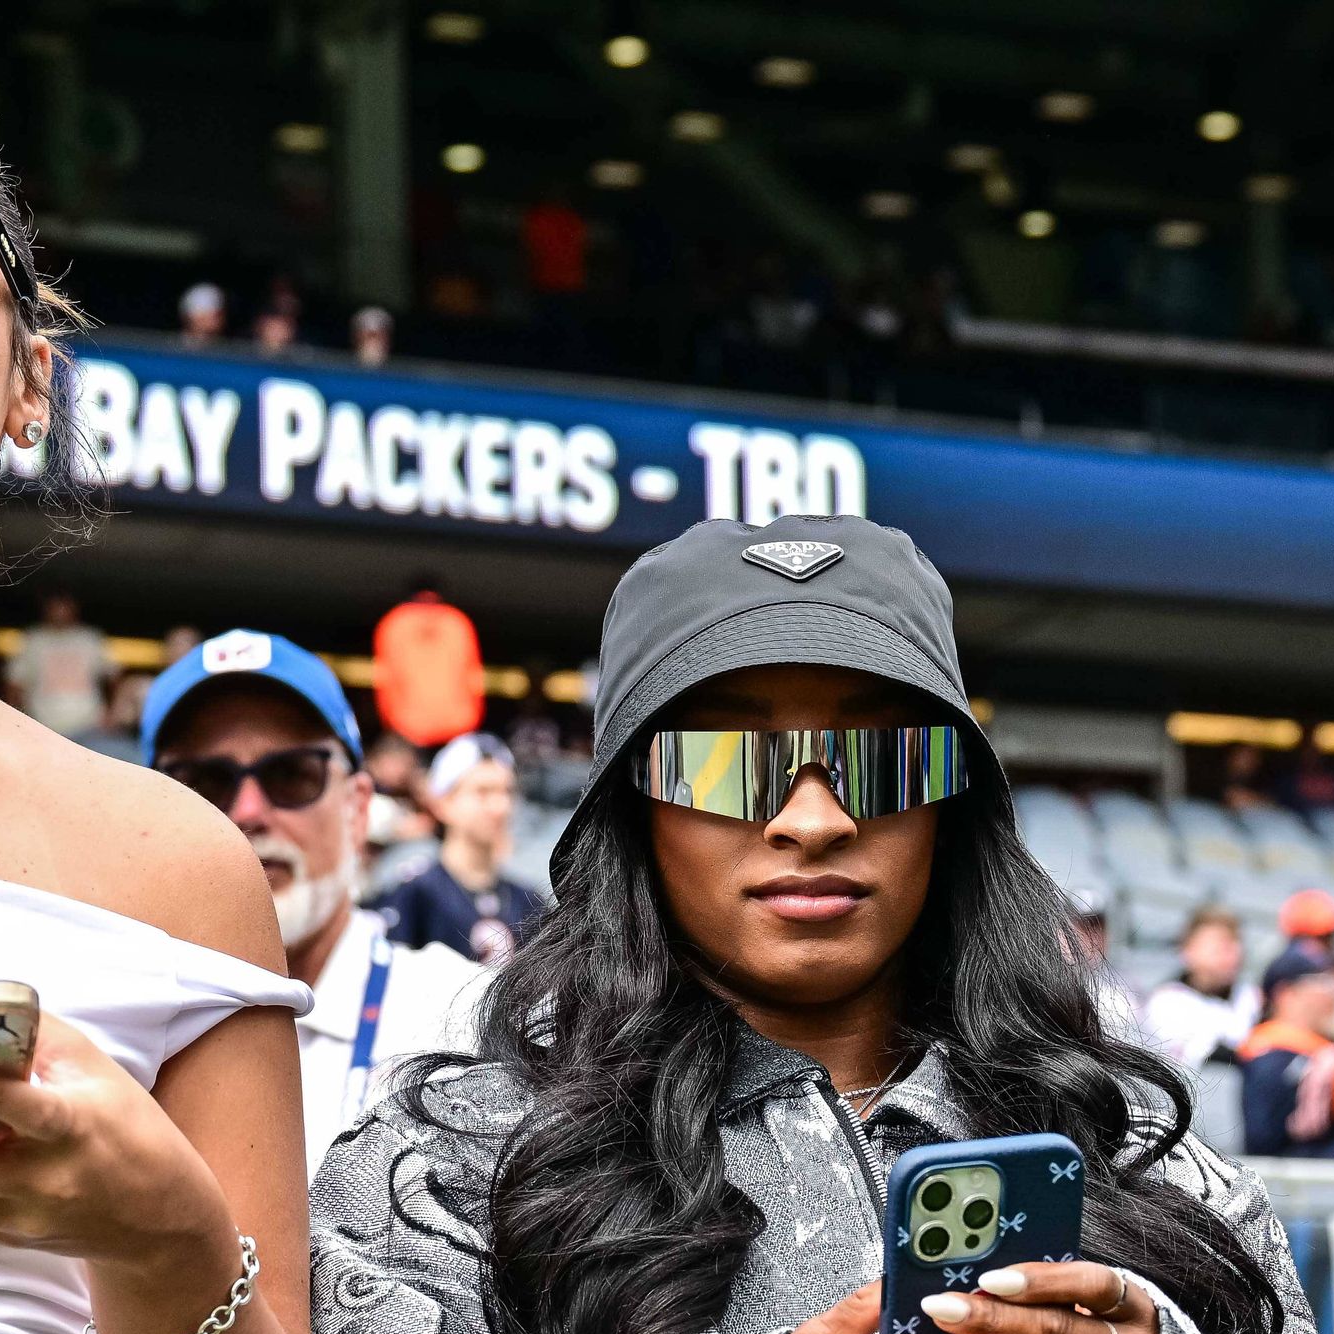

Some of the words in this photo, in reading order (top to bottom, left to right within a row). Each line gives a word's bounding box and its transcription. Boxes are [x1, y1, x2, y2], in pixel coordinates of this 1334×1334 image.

[69, 358, 241, 497] BAY
[258, 377, 619, 532] PACKERS
[763, 542, 827, 554] PRADA
